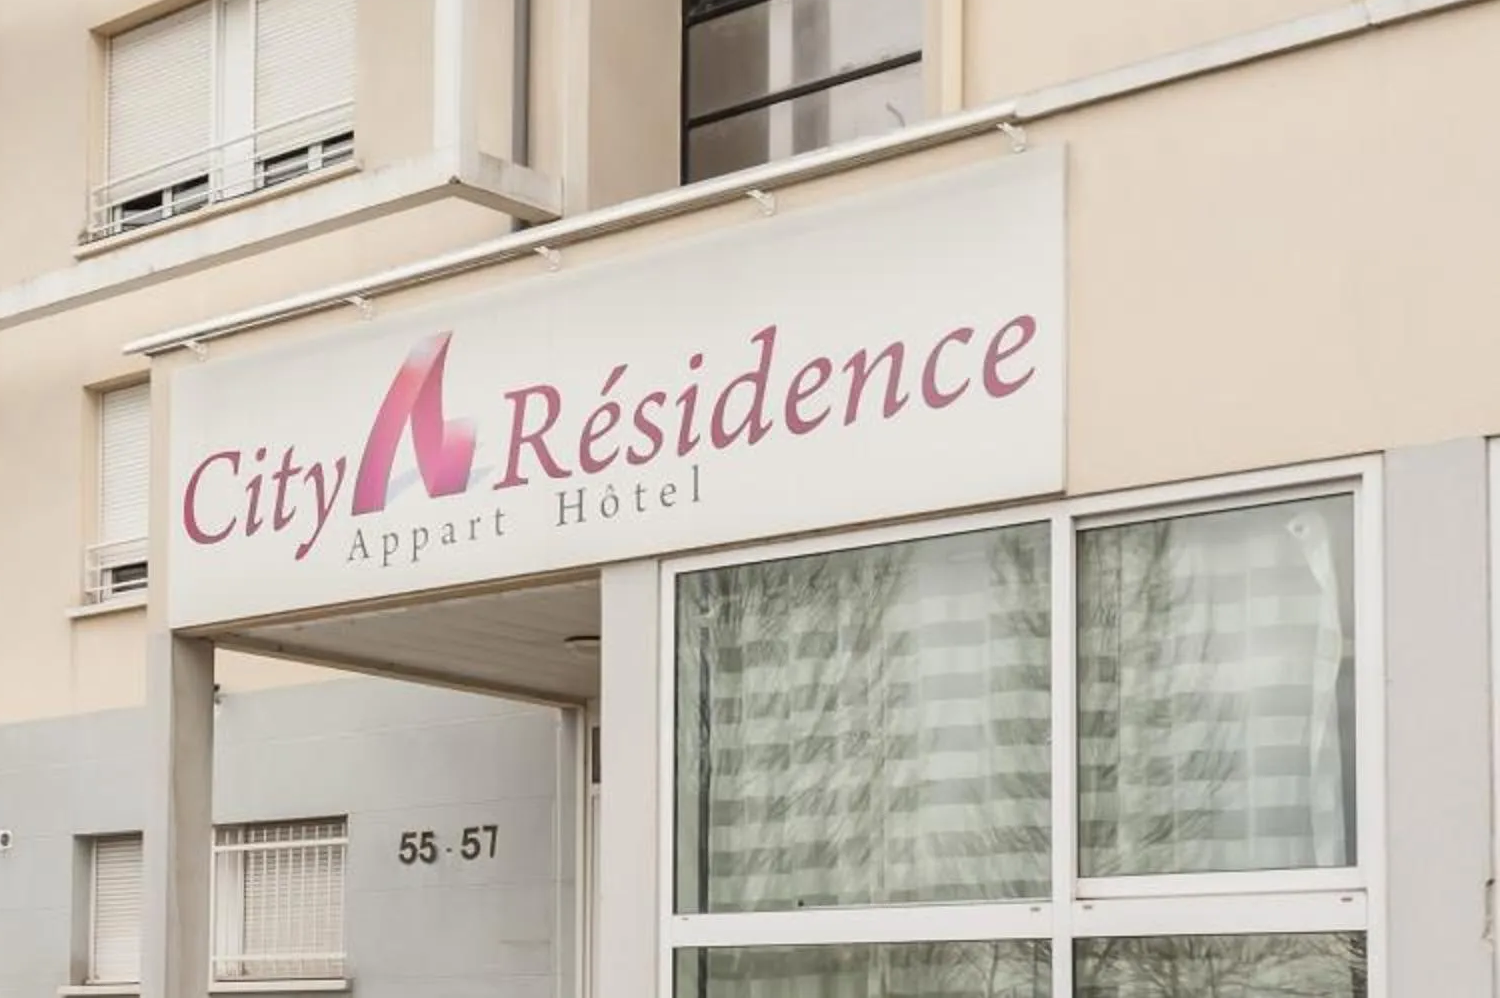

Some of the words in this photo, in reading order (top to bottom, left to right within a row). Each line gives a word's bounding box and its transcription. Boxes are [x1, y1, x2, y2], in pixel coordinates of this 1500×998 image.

[183, 445, 348, 561] City
[492, 314, 1037, 491] Résidence
[347, 507, 506, 568] Appart
[555, 464, 703, 528] Hôtel
